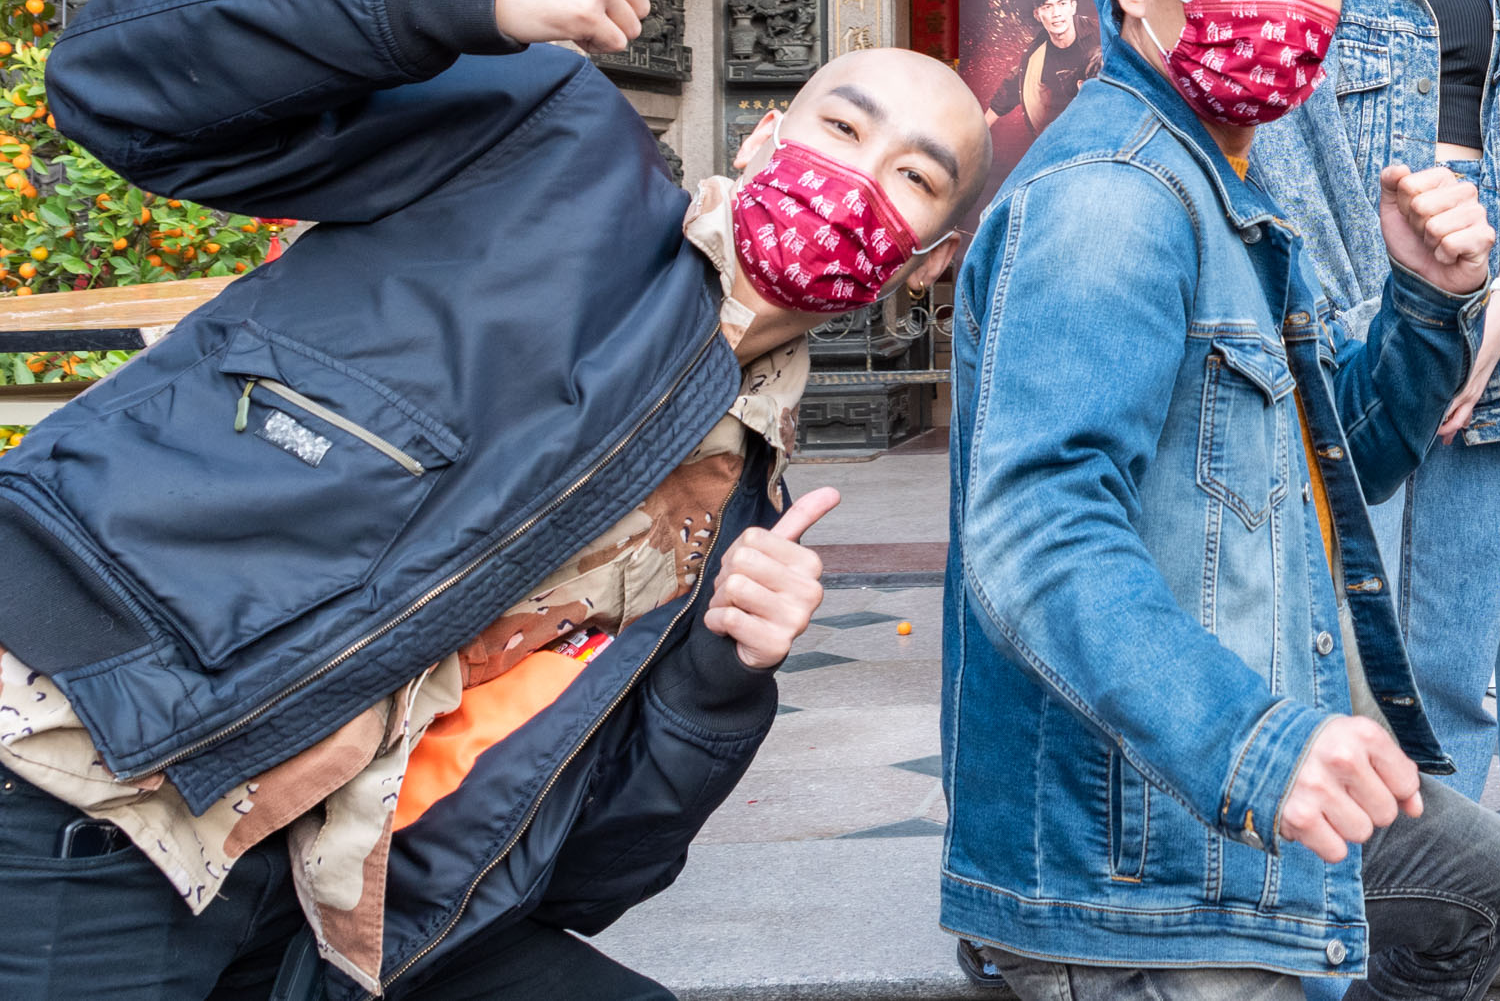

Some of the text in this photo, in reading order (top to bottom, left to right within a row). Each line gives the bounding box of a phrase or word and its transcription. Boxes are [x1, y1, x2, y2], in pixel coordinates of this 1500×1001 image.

[1207, 21, 1233, 41] 角頭
[1261, 21, 1286, 42] 角頭
[1200, 48, 1226, 72] 角頭
[1192, 69, 1214, 92] 角頭
[1249, 65, 1275, 86] 角頭
[798, 170, 826, 190] 角頭
[778, 196, 802, 218] 角頭
[811, 195, 836, 219] 角頭
[842, 189, 866, 218] 角頭
[757, 223, 778, 250] 角頭
[780, 227, 807, 256] 角頭
[814, 225, 840, 252] 角頭
[871, 228, 892, 256] 角頭
[855, 249, 873, 274] 角頭
[784, 262, 812, 289] 角頭
